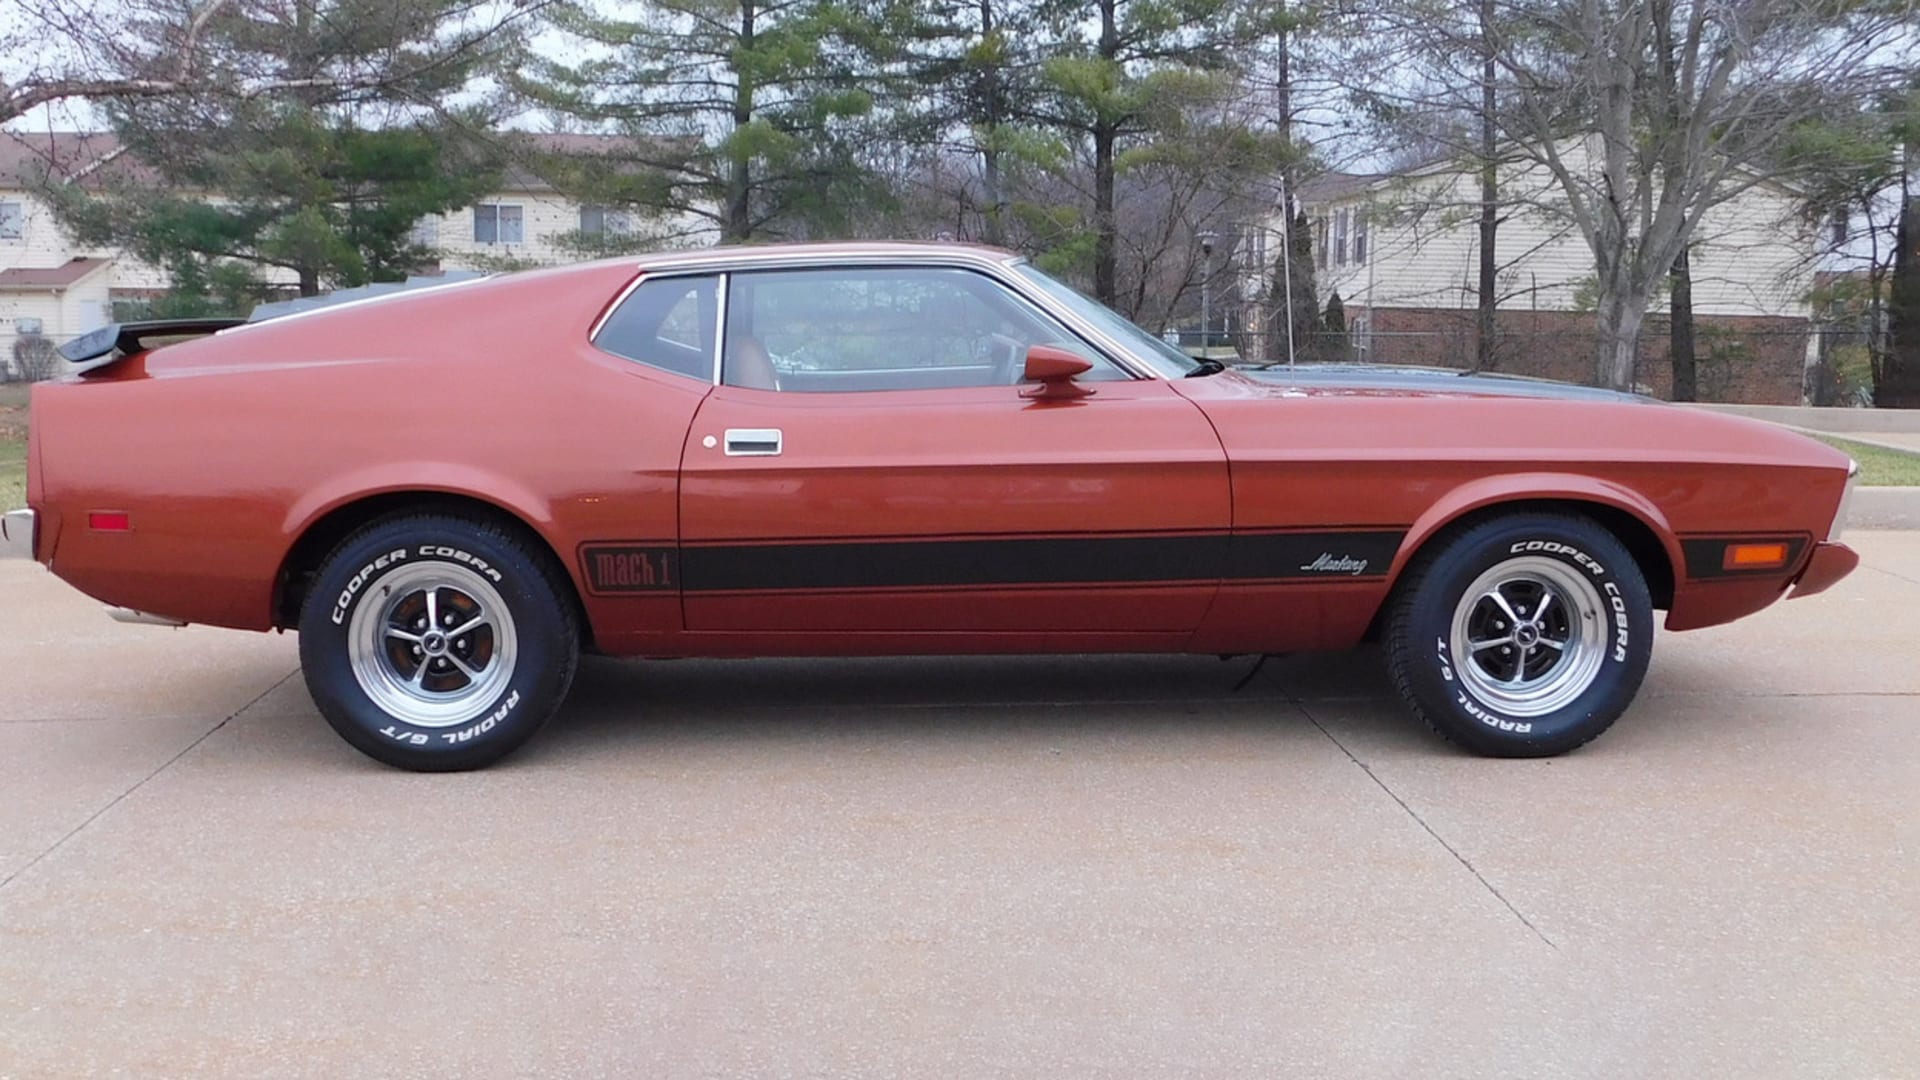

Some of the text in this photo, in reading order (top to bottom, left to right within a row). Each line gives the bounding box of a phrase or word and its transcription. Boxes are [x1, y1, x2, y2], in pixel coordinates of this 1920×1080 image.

[332, 545, 502, 625] COOPER COBRA
[661, 552, 671, 585] 1
[1510, 540, 1629, 662] COOPER COBRA
[379, 689, 520, 745] RADIAL G/T
[1437, 636, 1532, 733] RADIAL G/T
